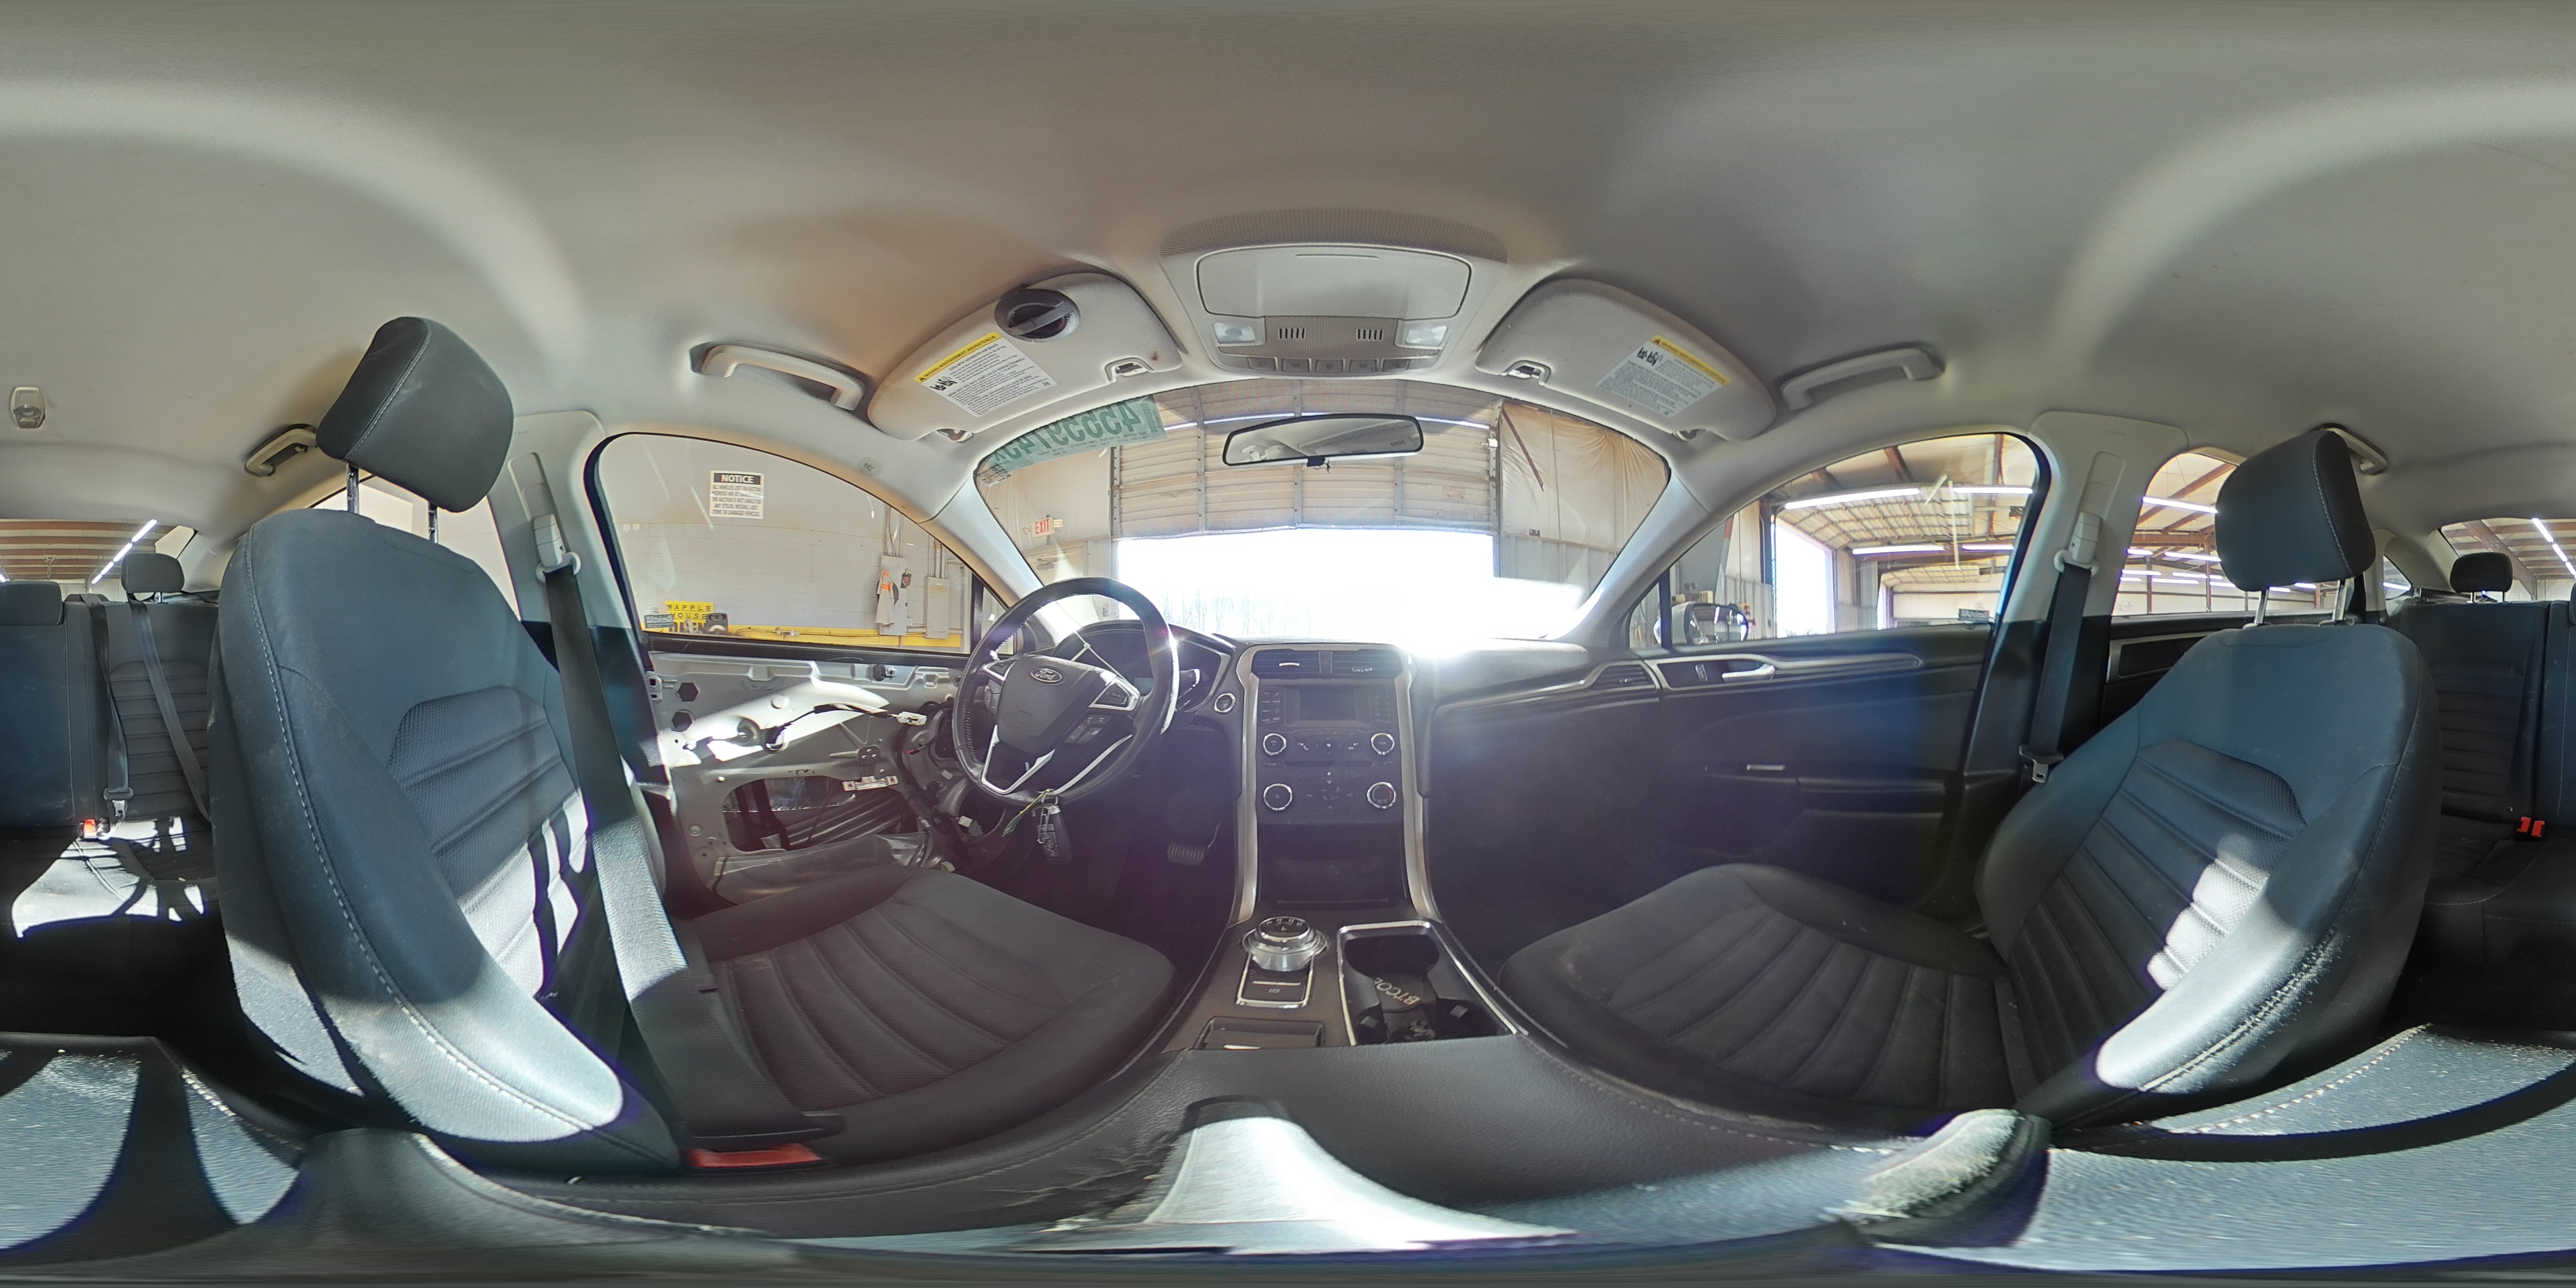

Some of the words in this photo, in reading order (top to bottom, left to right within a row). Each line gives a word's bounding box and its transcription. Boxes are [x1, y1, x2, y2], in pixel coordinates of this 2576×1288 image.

[721, 474, 754, 483] NOTICE
[1035, 518, 1050, 534] EXIT
[1035, 669, 1057, 680] Ford
